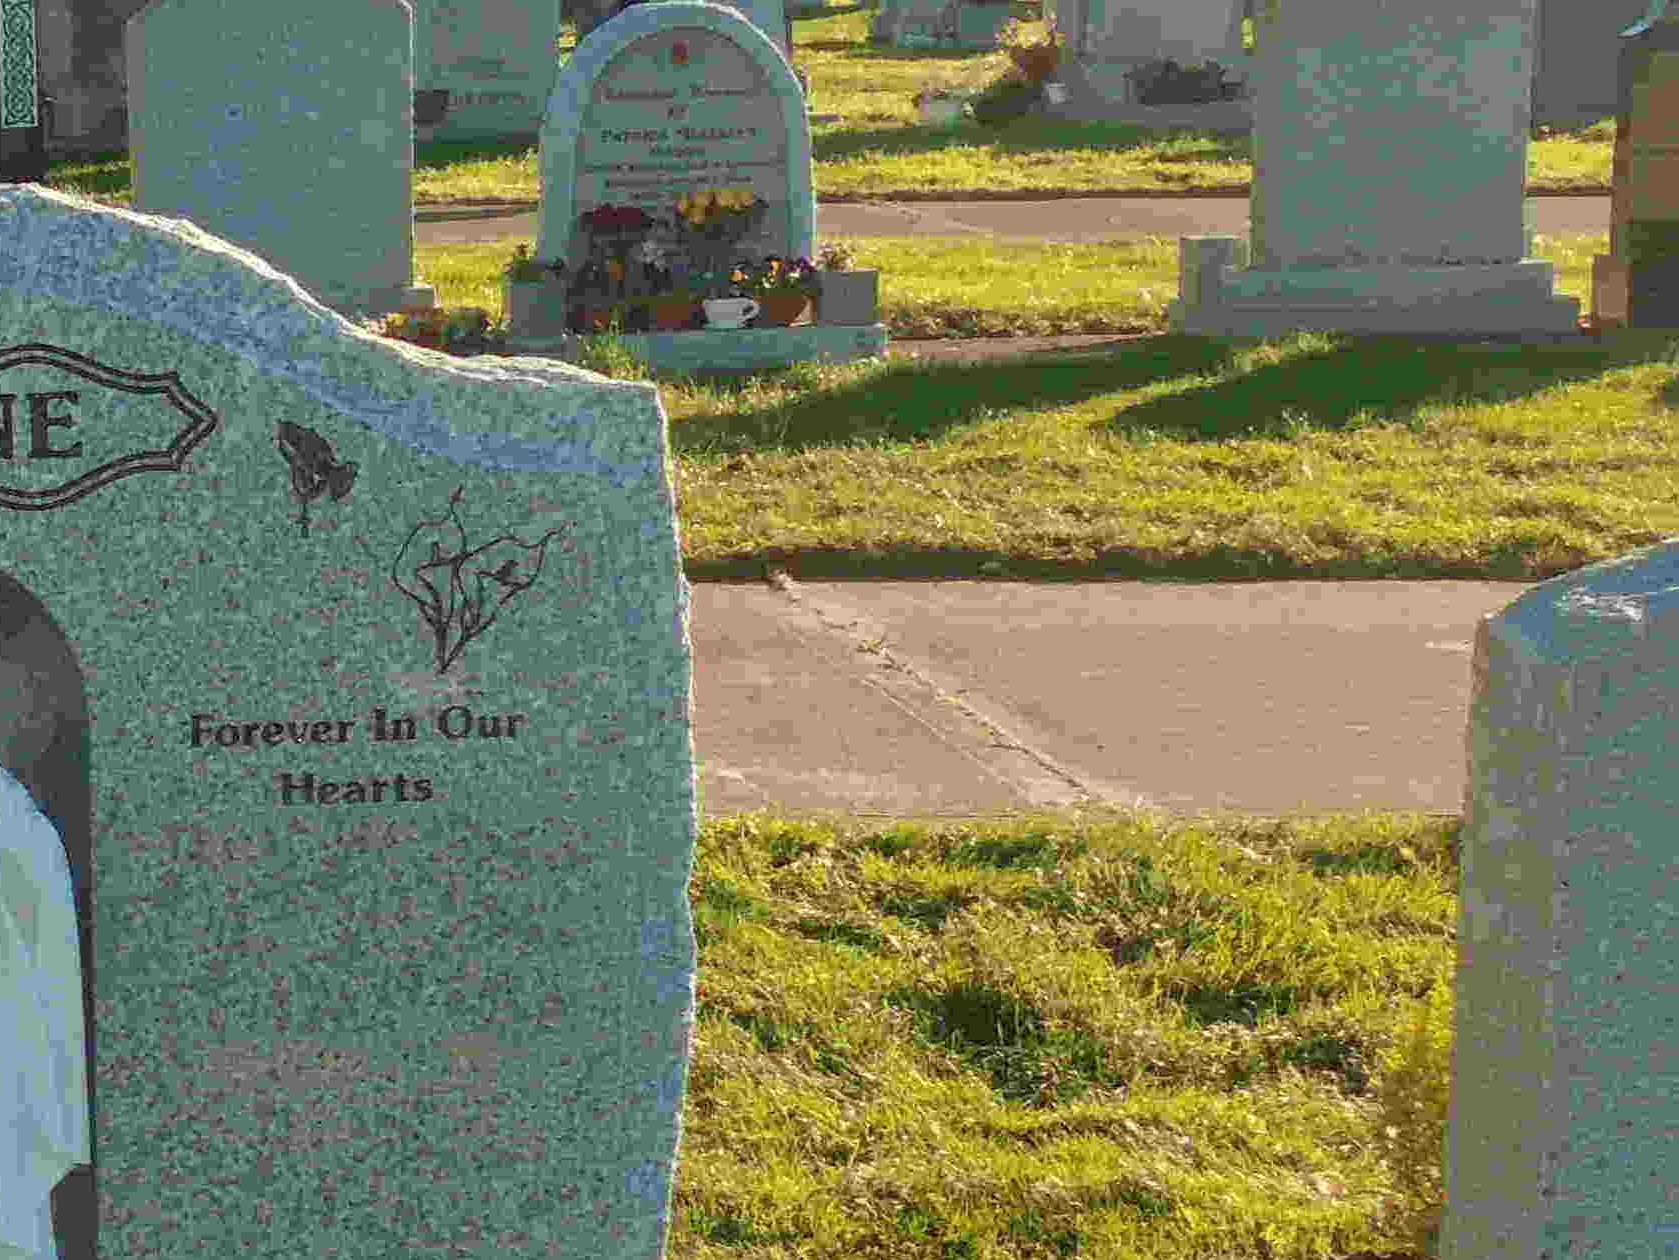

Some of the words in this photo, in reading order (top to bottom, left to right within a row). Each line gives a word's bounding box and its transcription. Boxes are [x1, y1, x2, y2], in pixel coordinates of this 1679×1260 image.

[192, 711, 354, 747] Forever
[372, 706, 418, 744] In
[437, 704, 525, 740] Our
[284, 773, 433, 808] Hearts
